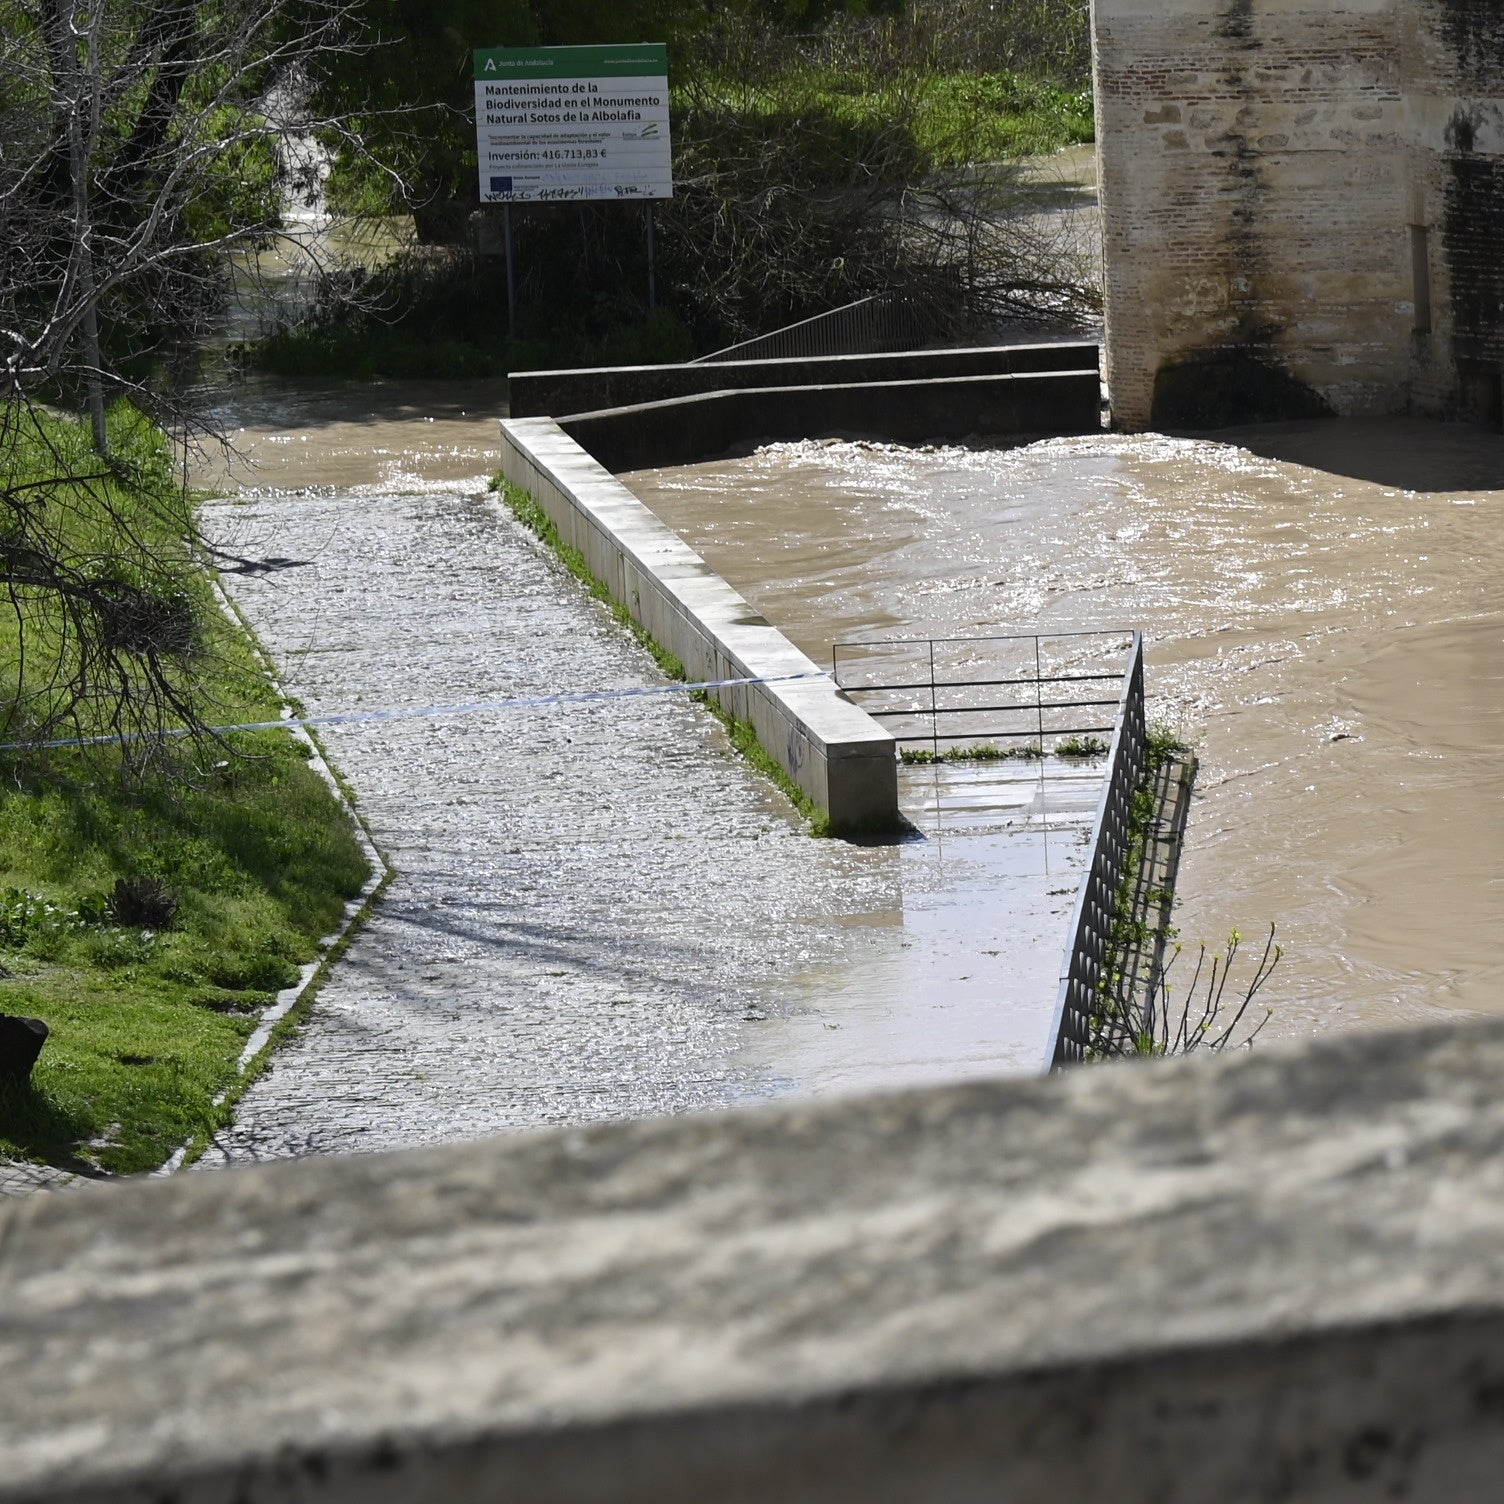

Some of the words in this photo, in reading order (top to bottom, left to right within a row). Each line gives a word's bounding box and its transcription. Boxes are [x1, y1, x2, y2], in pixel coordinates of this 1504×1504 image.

[485, 84, 569, 95] Mantenimiento
[571, 82, 586, 93] de
[588, 82, 598, 93] la
[486, 98, 562, 110] Biodiversidad
[564, 99, 578, 108] en
[580, 96, 590, 107] el
[593, 96, 660, 107] Monumento
[486, 113, 528, 124] Natural
[530, 113, 560, 123] Sotos
[563, 111, 577, 122] de
[579, 111, 590, 122] la
[489, 150, 540, 161] Inversión:
[542, 150, 598, 160] 416.713,83
[600, 149, 607, 158] €
